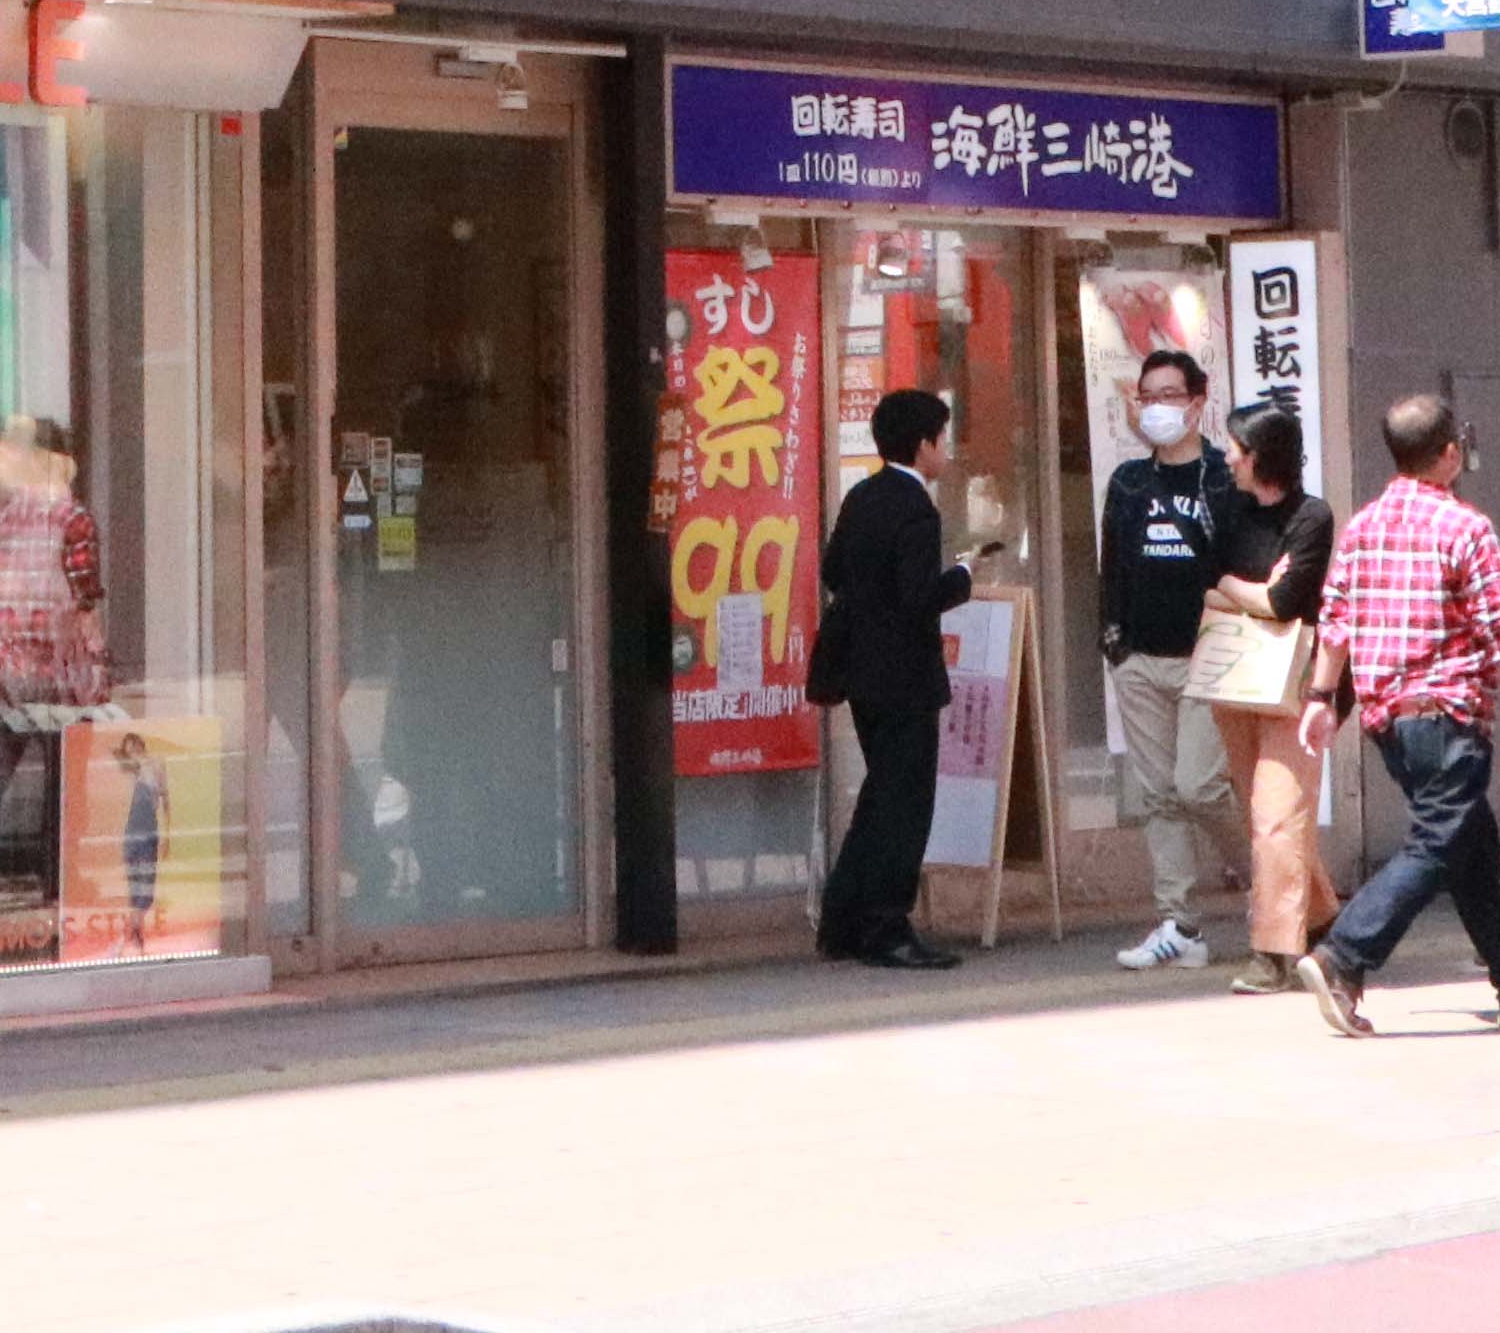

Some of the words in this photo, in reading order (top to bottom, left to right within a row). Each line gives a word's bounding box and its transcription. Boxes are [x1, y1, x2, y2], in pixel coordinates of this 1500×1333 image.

[791, 92, 906, 143] 回転寿司
[930, 103, 1195, 199] 海鮮三崎港
[694, 272, 777, 335] すし
[692, 344, 786, 489] 祭
[670, 514, 801, 669] 99
